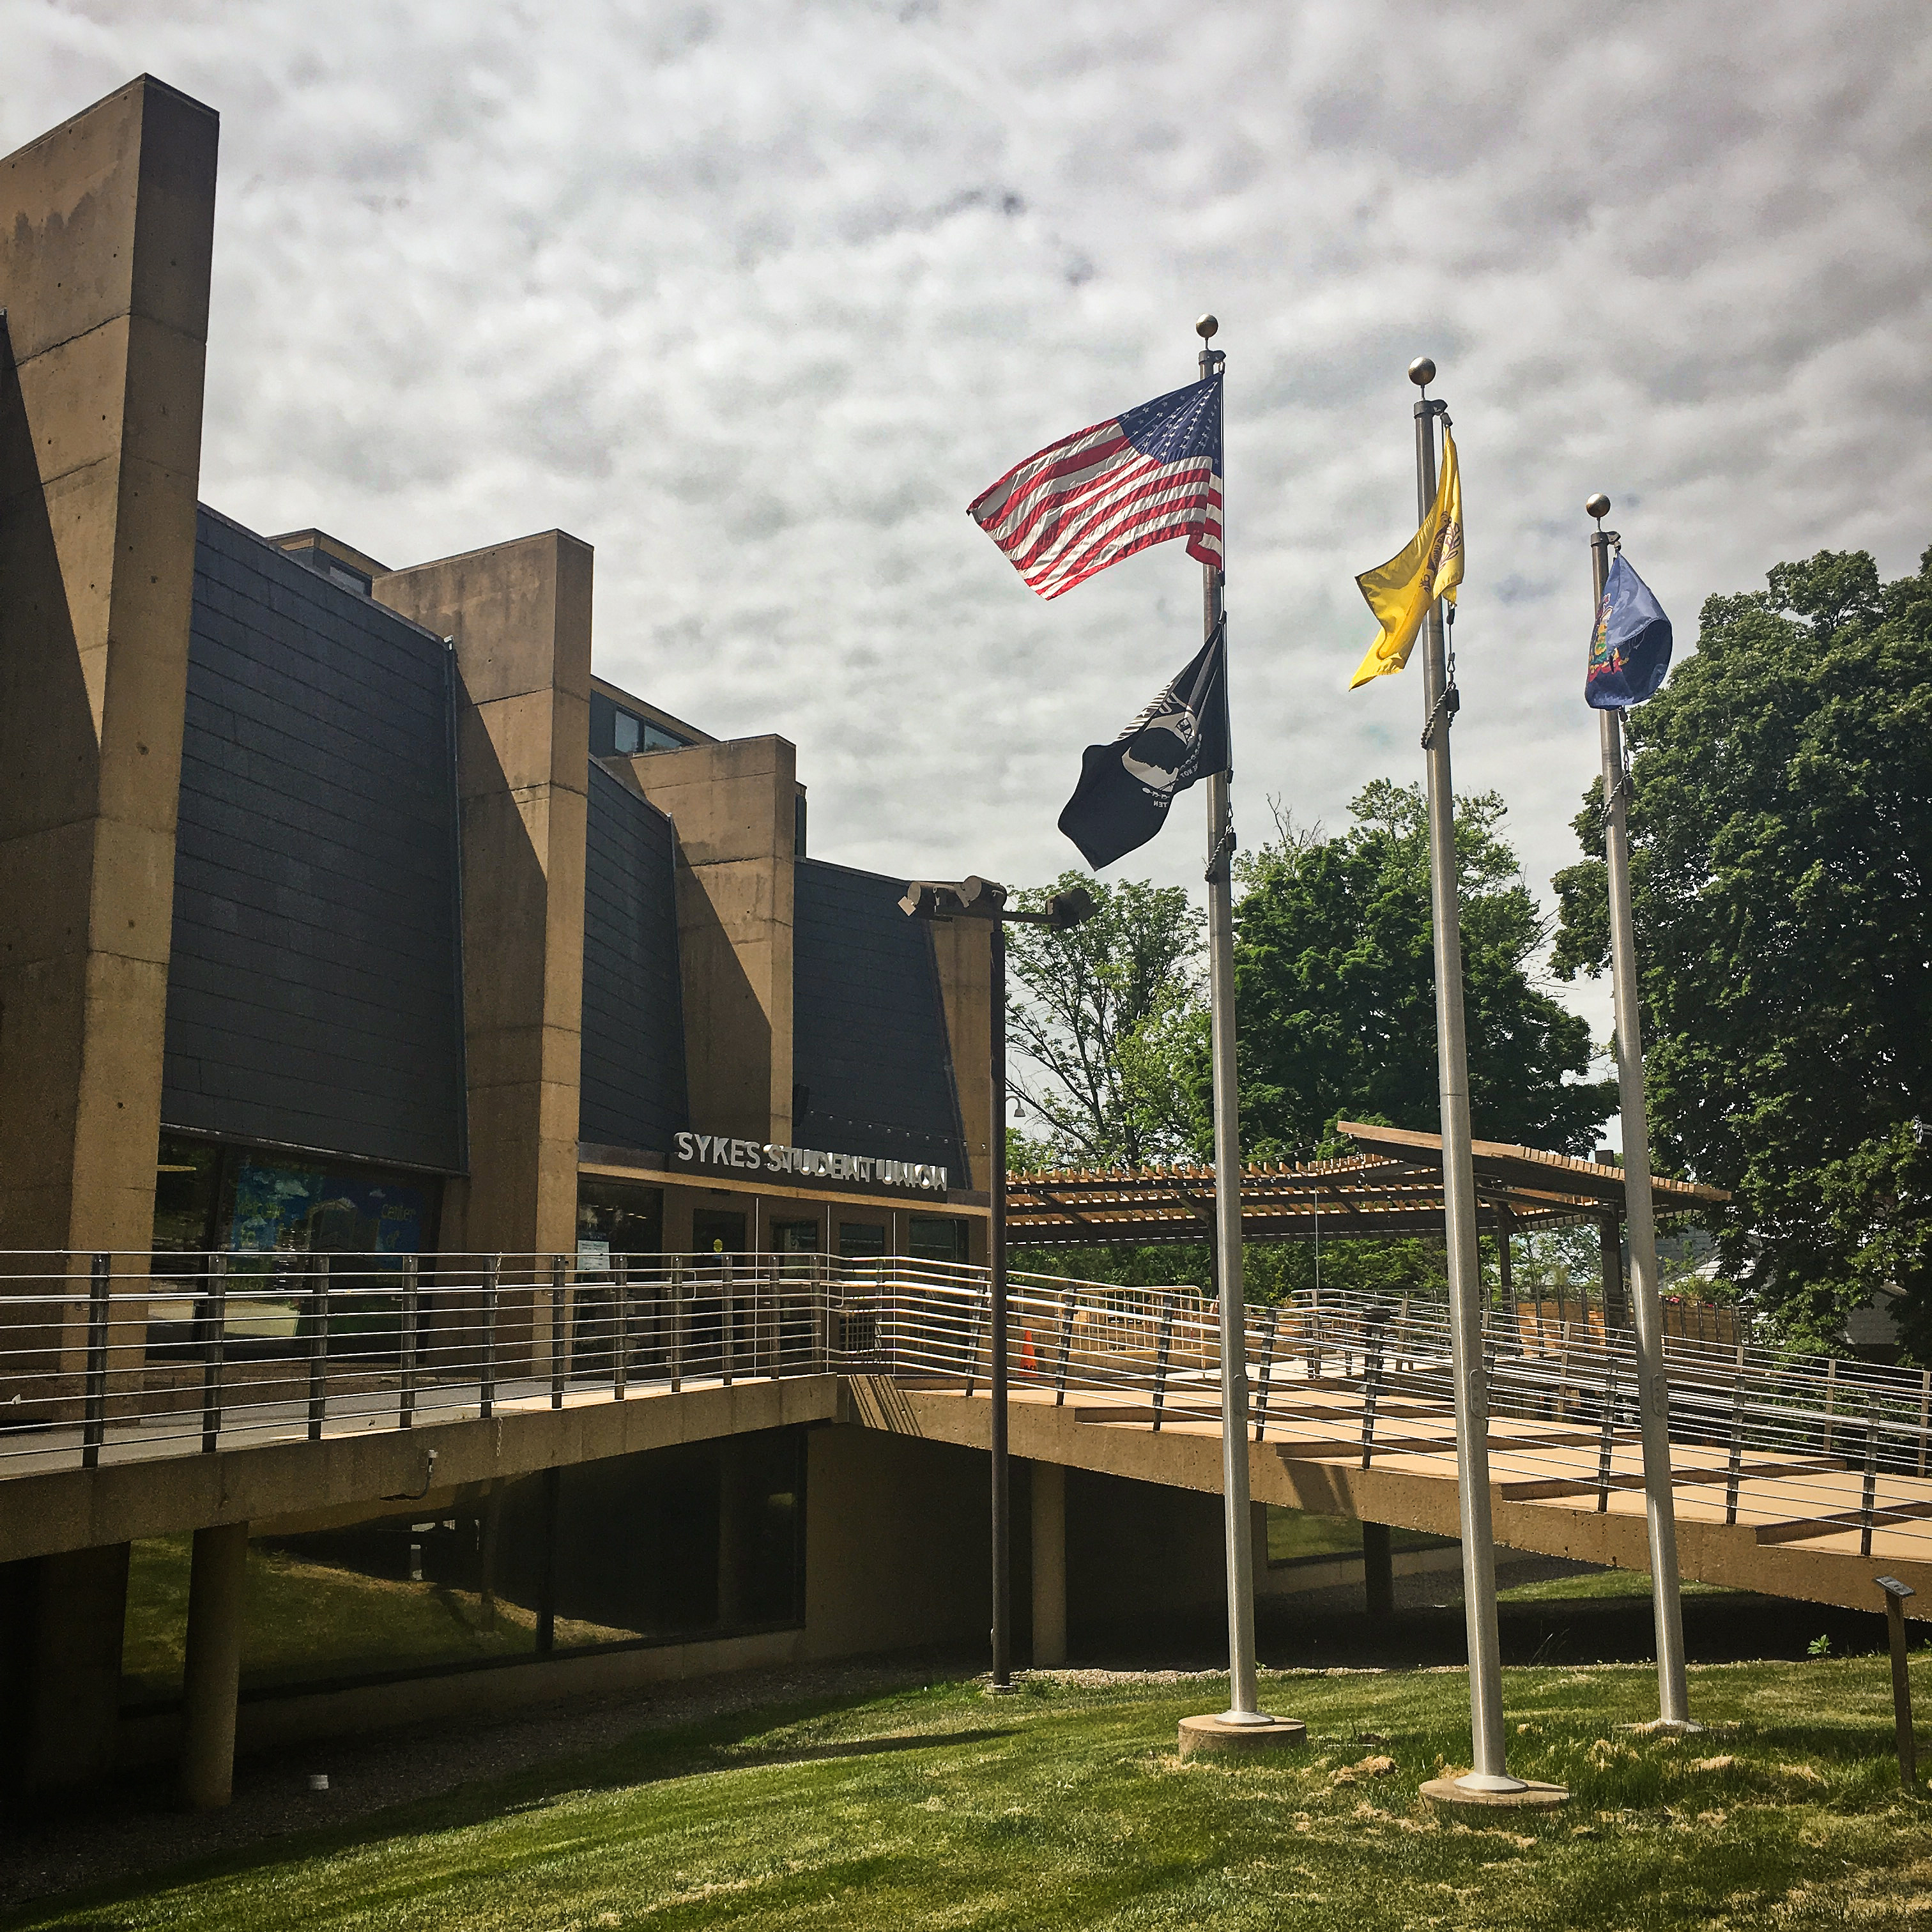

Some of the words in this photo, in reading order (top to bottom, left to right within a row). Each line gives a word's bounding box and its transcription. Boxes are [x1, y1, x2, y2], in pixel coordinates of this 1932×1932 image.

[674, 1132, 760, 1169] SYKES
[764, 1144, 875, 1183] STUDENT
[876, 1159, 947, 1192] UNION
